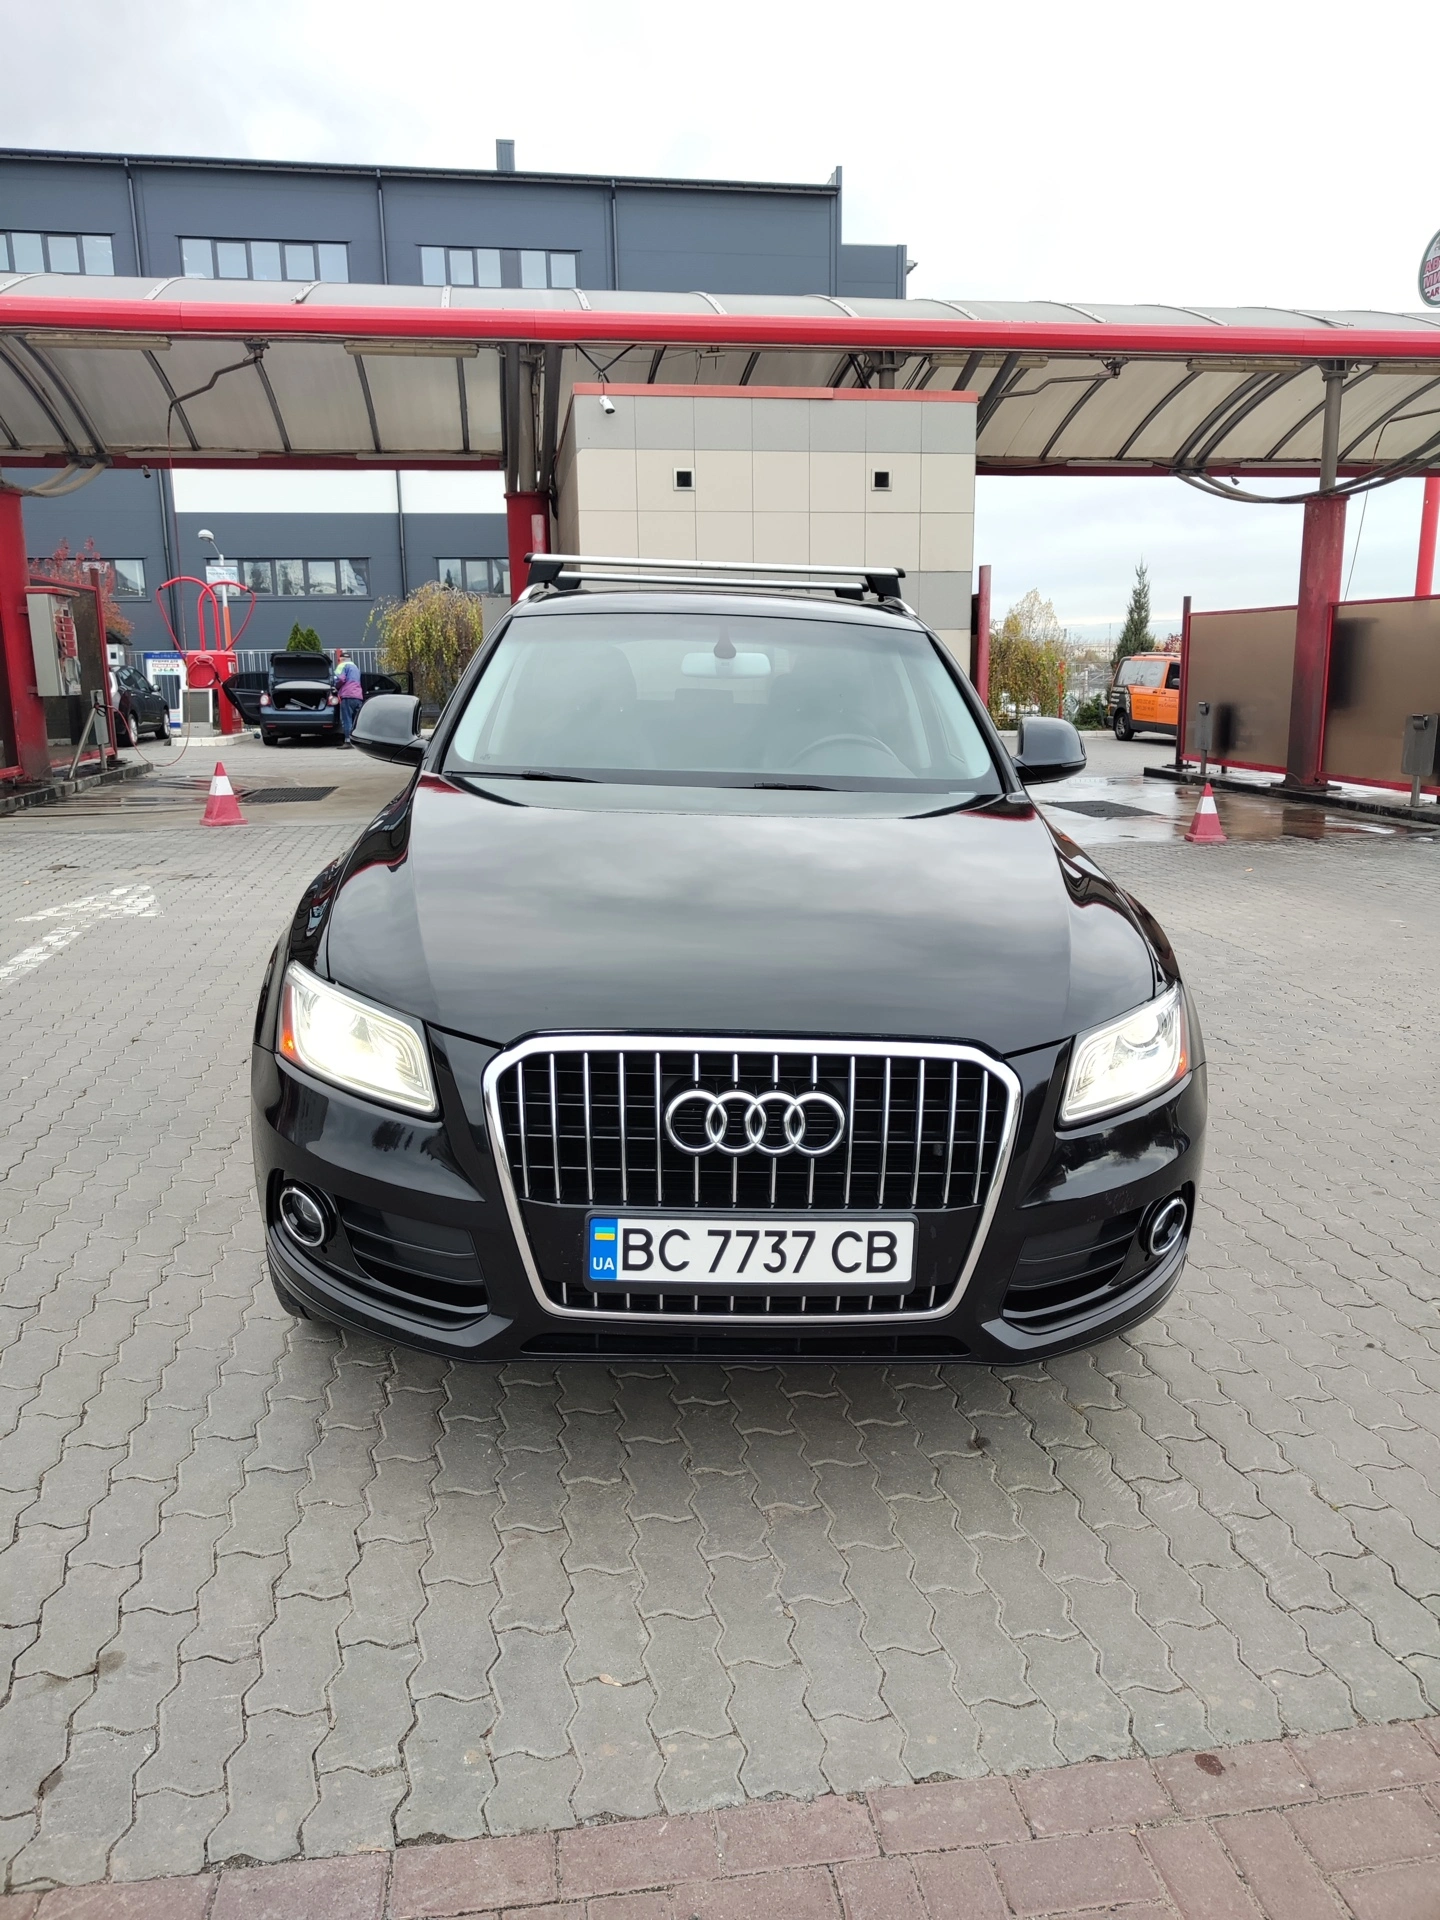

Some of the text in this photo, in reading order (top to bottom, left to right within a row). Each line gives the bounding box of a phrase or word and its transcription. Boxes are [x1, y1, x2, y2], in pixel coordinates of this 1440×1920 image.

[1424, 256, 1440, 273] АВ
[622, 1228, 898, 1274] BC 7737 CB
[592, 1257, 615, 1271] UA
